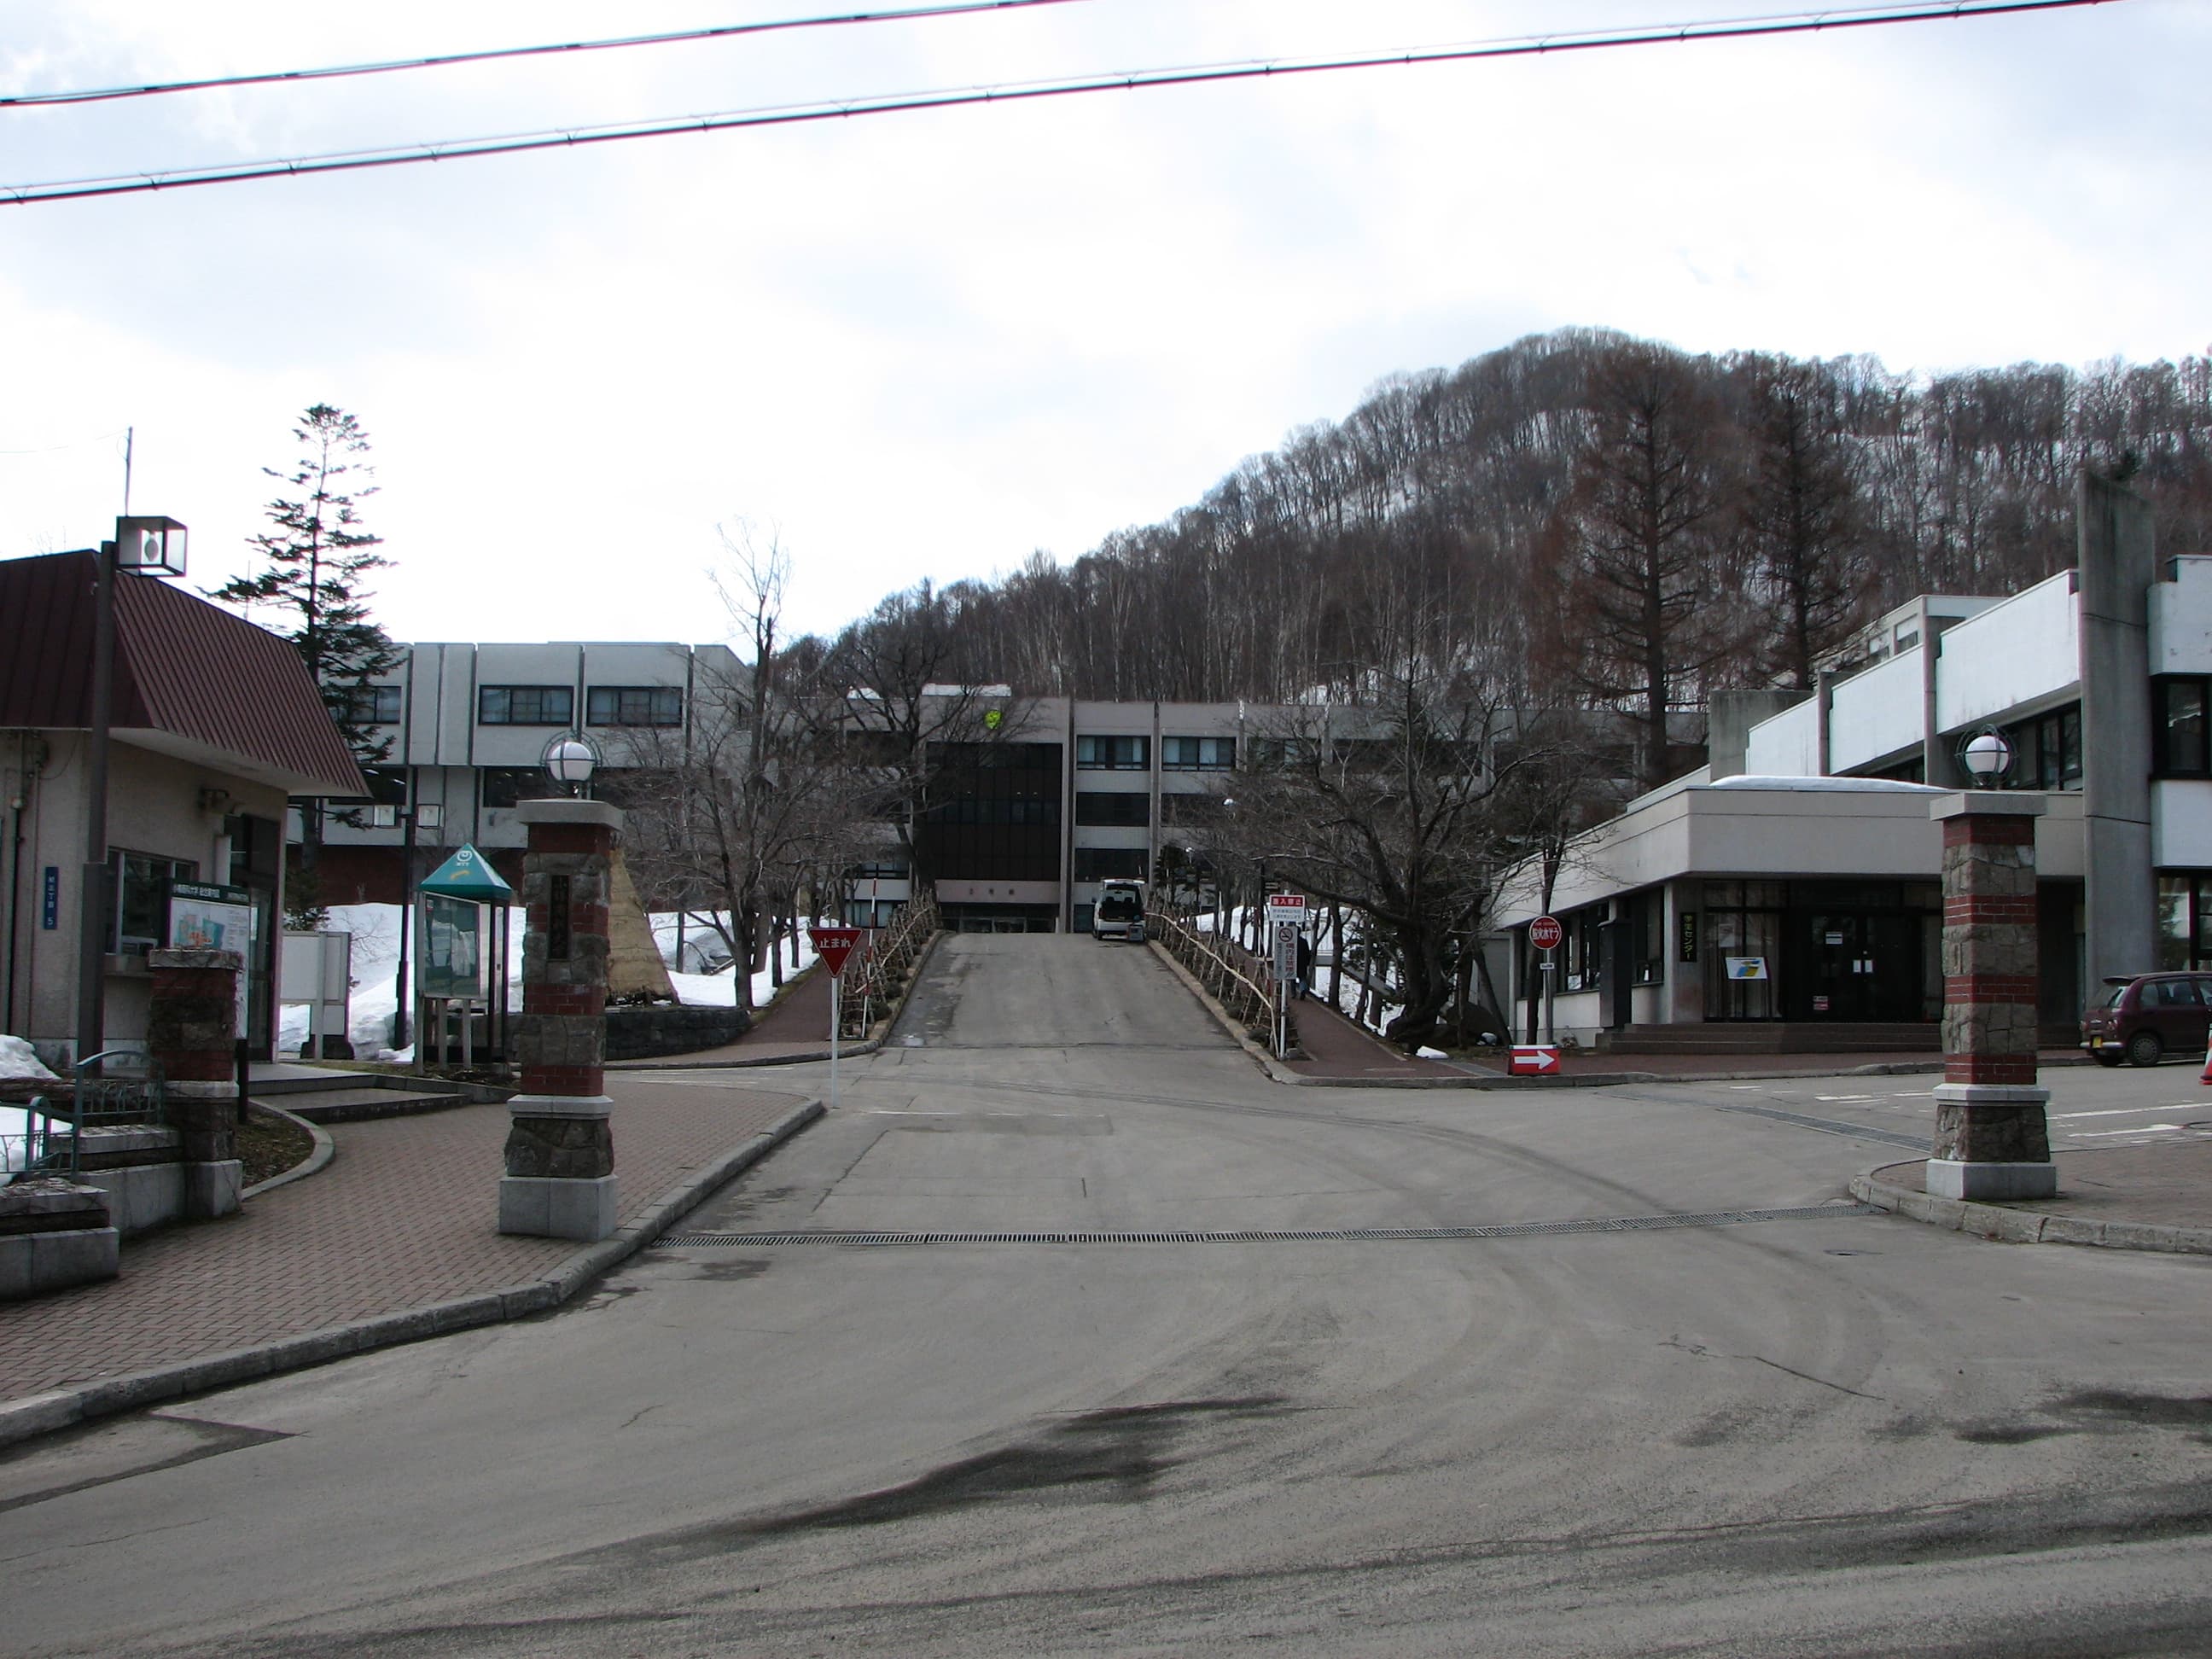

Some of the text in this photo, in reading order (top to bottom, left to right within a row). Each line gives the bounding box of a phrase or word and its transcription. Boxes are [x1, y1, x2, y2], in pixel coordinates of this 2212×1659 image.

[47, 916, 54, 926] 5
[819, 937, 852, 948] 止まれ
[1684, 915, 1693, 959] 学生センター
